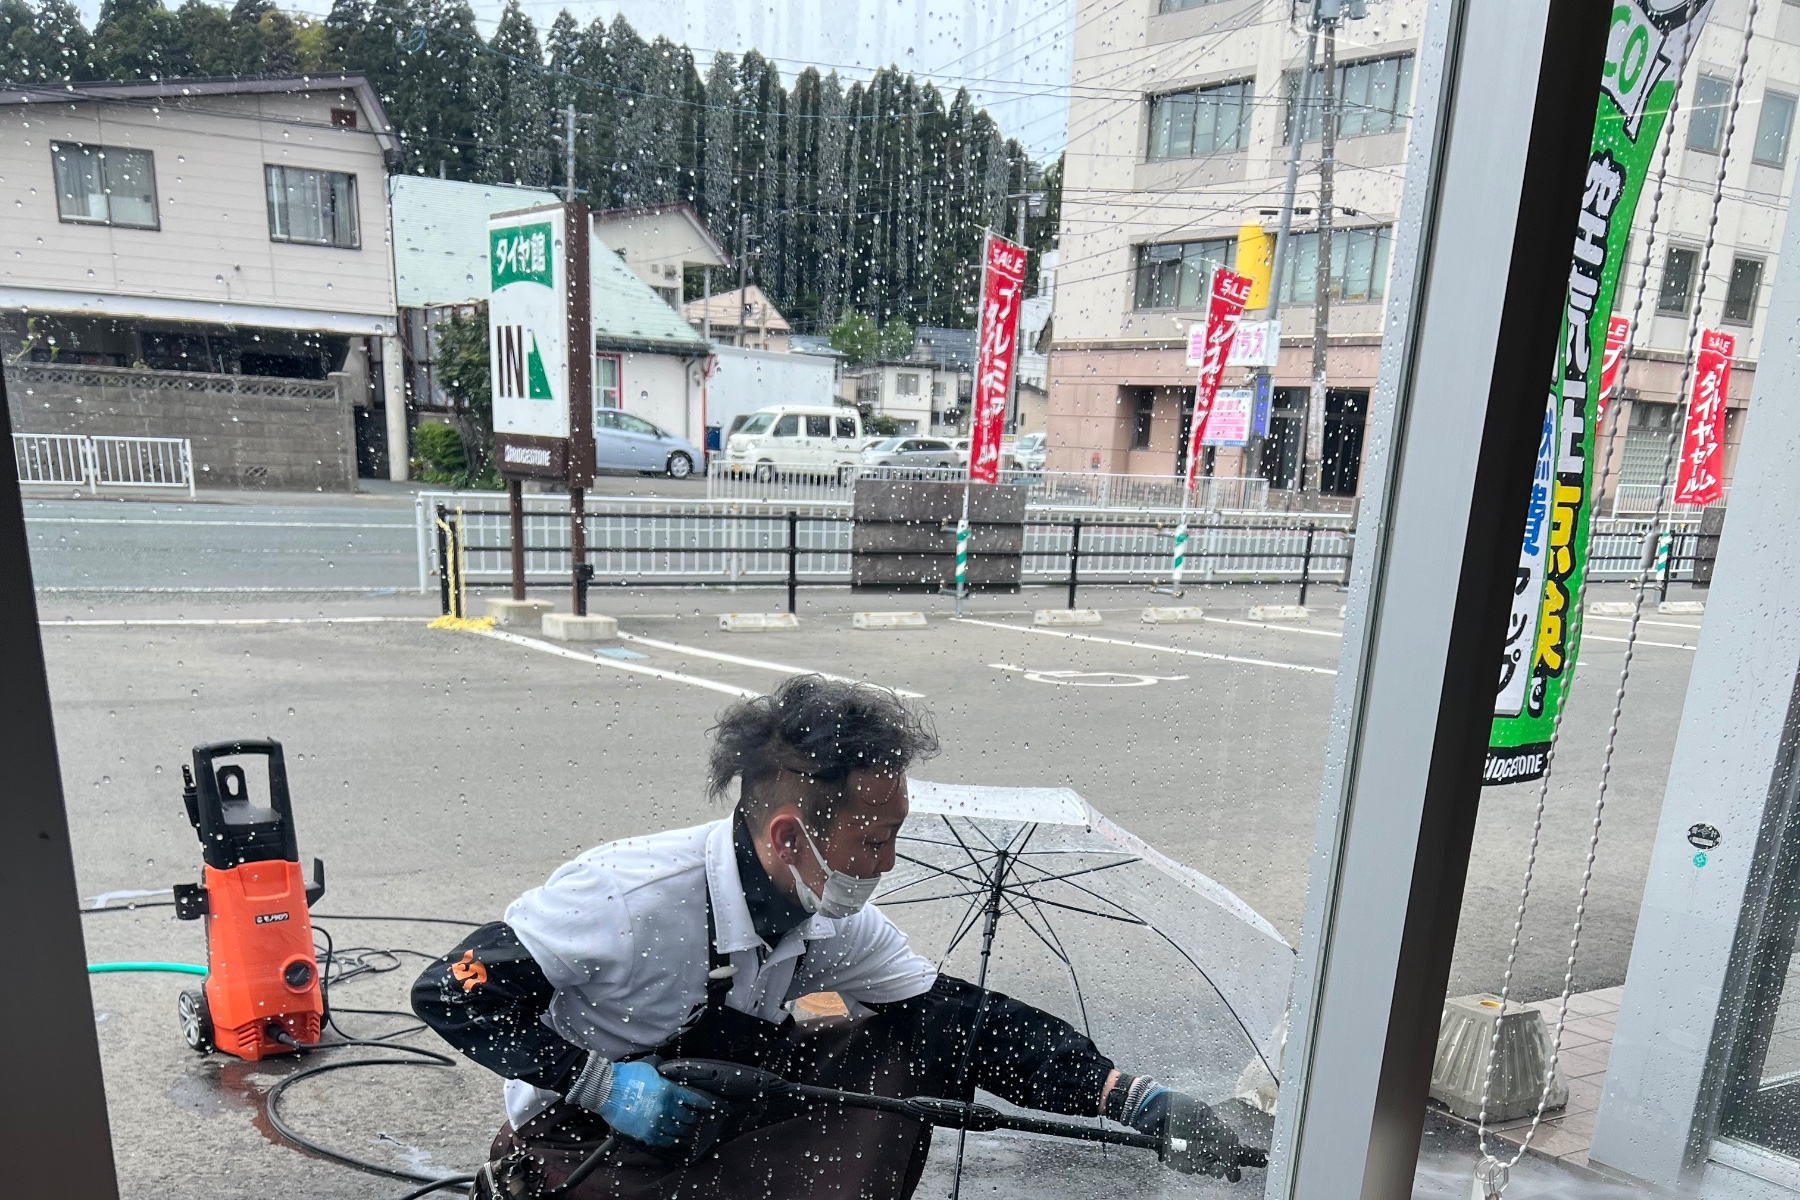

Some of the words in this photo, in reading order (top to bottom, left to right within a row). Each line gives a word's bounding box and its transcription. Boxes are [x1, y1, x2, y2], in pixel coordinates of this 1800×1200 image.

[496, 231, 547, 275] タイヤ館
[993, 249, 1024, 273] SALE
[1220, 278, 1251, 300] SLE
[1708, 337, 1732, 351] SALE
[496, 325, 525, 398] IN
[1682, 370, 1717, 493] タイヤセール
